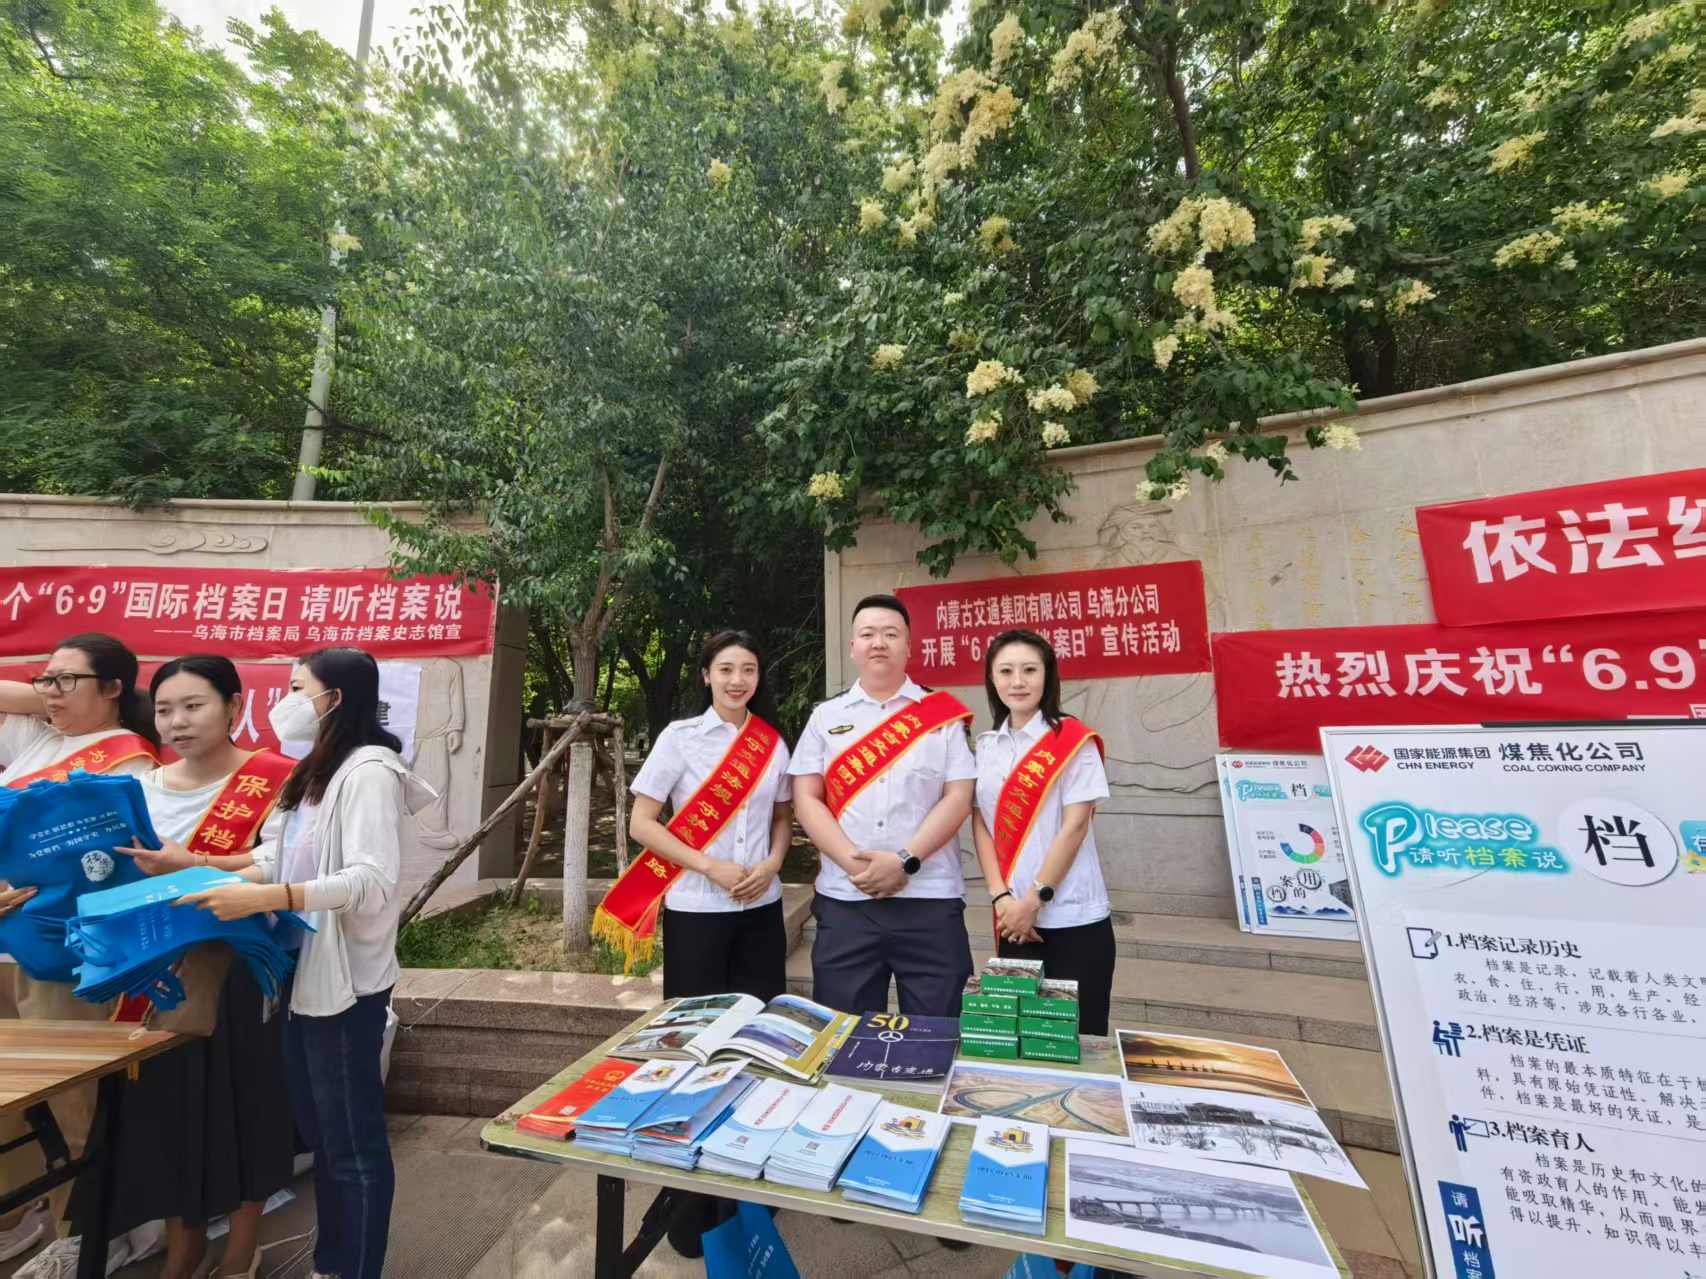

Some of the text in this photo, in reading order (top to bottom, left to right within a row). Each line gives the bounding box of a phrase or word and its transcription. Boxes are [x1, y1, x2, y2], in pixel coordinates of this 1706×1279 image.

[300, 583, 463, 622] 请听档案说
[936, 582, 1160, 631] 内蒙古交通集团有限公司 乌海分公司
[305, 623, 463, 643] 乌海市档案史志馆宣
[1101, 618, 1181, 657] 宣传活动
[1394, 742, 1645, 762] 国家能源集团 煤焦化公司
[1397, 762, 1646, 773] CHN ENERGY COAL COKING COMPANY
[194, 774, 271, 857] 保护档
[1365, 804, 1534, 874] Please
[1577, 815, 1655, 868] 档
[1410, 847, 1563, 870] 请听档案说
[1446, 931, 1582, 959] 1.档案记录历史
[866, 1014, 910, 1031] 50
[1467, 1023, 1590, 1054] 2.档案是凭证
[1489, 1121, 1595, 1153] 3.档案育人
